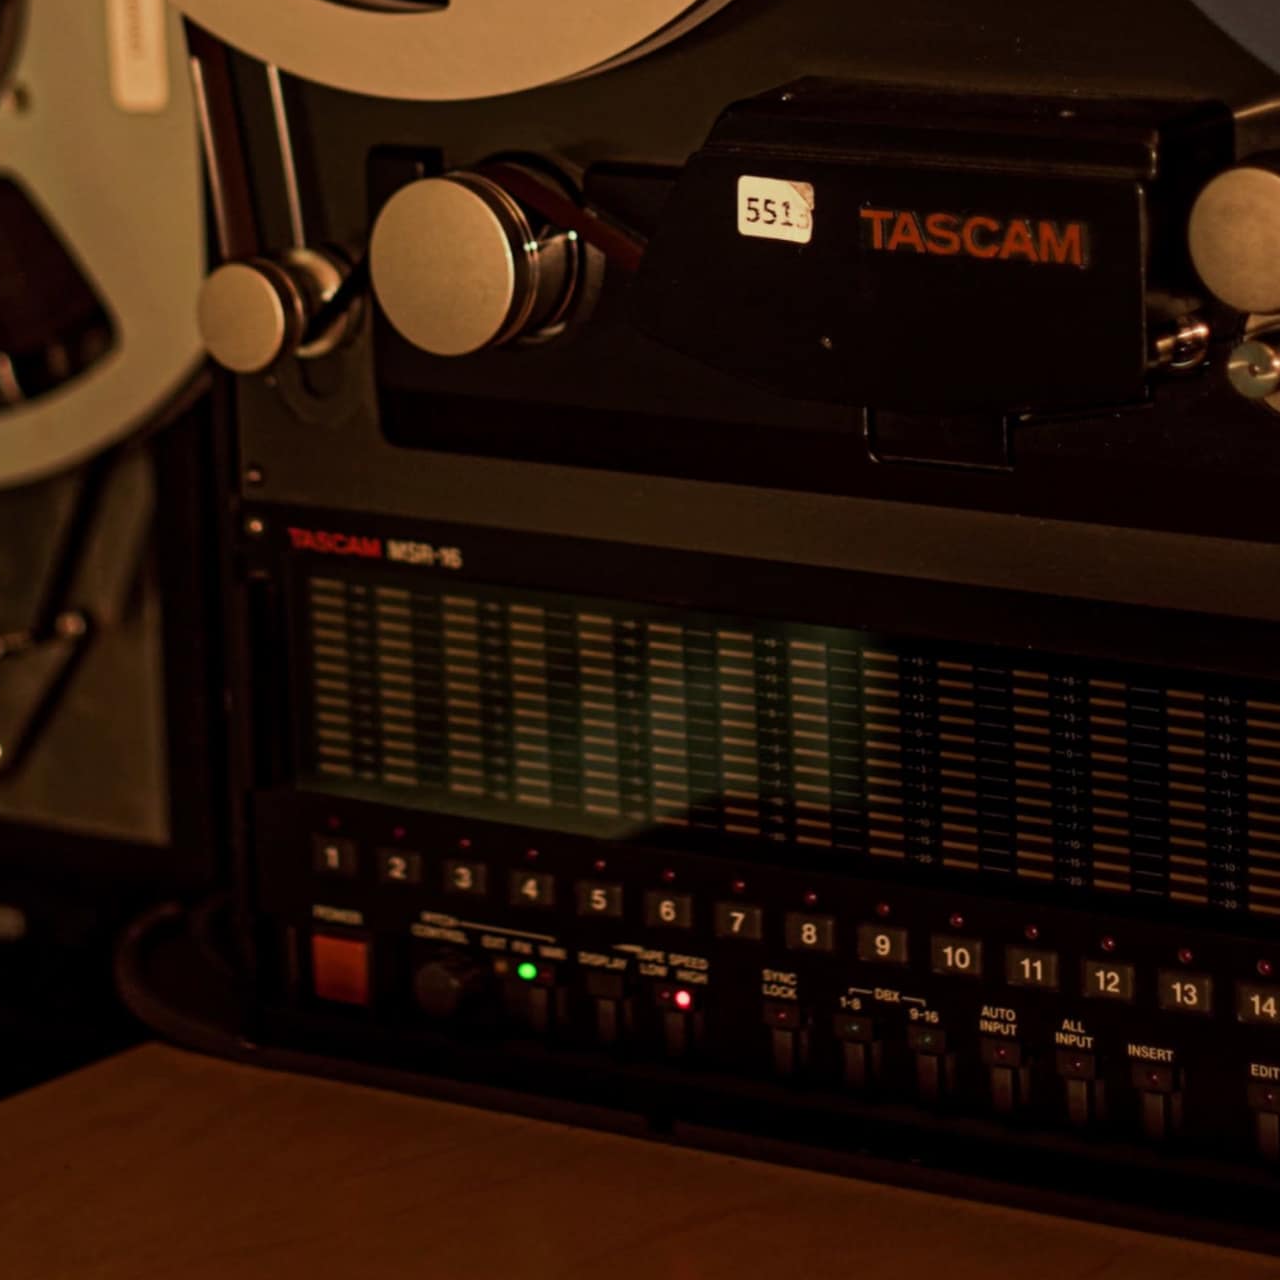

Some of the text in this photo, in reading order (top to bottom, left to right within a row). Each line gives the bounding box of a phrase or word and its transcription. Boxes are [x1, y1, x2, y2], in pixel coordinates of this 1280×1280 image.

[859, 207, 1086, 266] TASCAM
[287, 526, 382, 559] TASCAM
[324, 844, 339, 870] 1
[387, 855, 408, 881] 2
[452, 866, 472, 891] 3
[520, 877, 540, 900] 4
[590, 889, 609, 911] 5
[659, 899, 676, 922] 6
[728, 911, 745, 934] 7
[800, 922, 818, 945] 8
[874, 934, 891, 957] 9
[942, 945, 970, 969] 10
[1020, 958, 1043, 981] 11
[1095, 970, 1120, 993] 12
[1171, 981, 1198, 1005] 13
[1250, 994, 1277, 1018] 14
[762, 968, 797, 986] SYNC
[761, 983, 798, 1000] LOCK
[874, 987, 901, 1004] DBX
[840, 996, 862, 1011] 1-8
[909, 1007, 940, 1024] 9-16
[981, 1005, 1016, 1021] AUTO
[979, 1019, 1018, 1037] INPUT
[1061, 1018, 1085, 1034] ALL
[1055, 1031, 1094, 1049] INPUT
[1127, 1043, 1174, 1063] INSERT
[1250, 1063, 1280, 1080] EDIT
